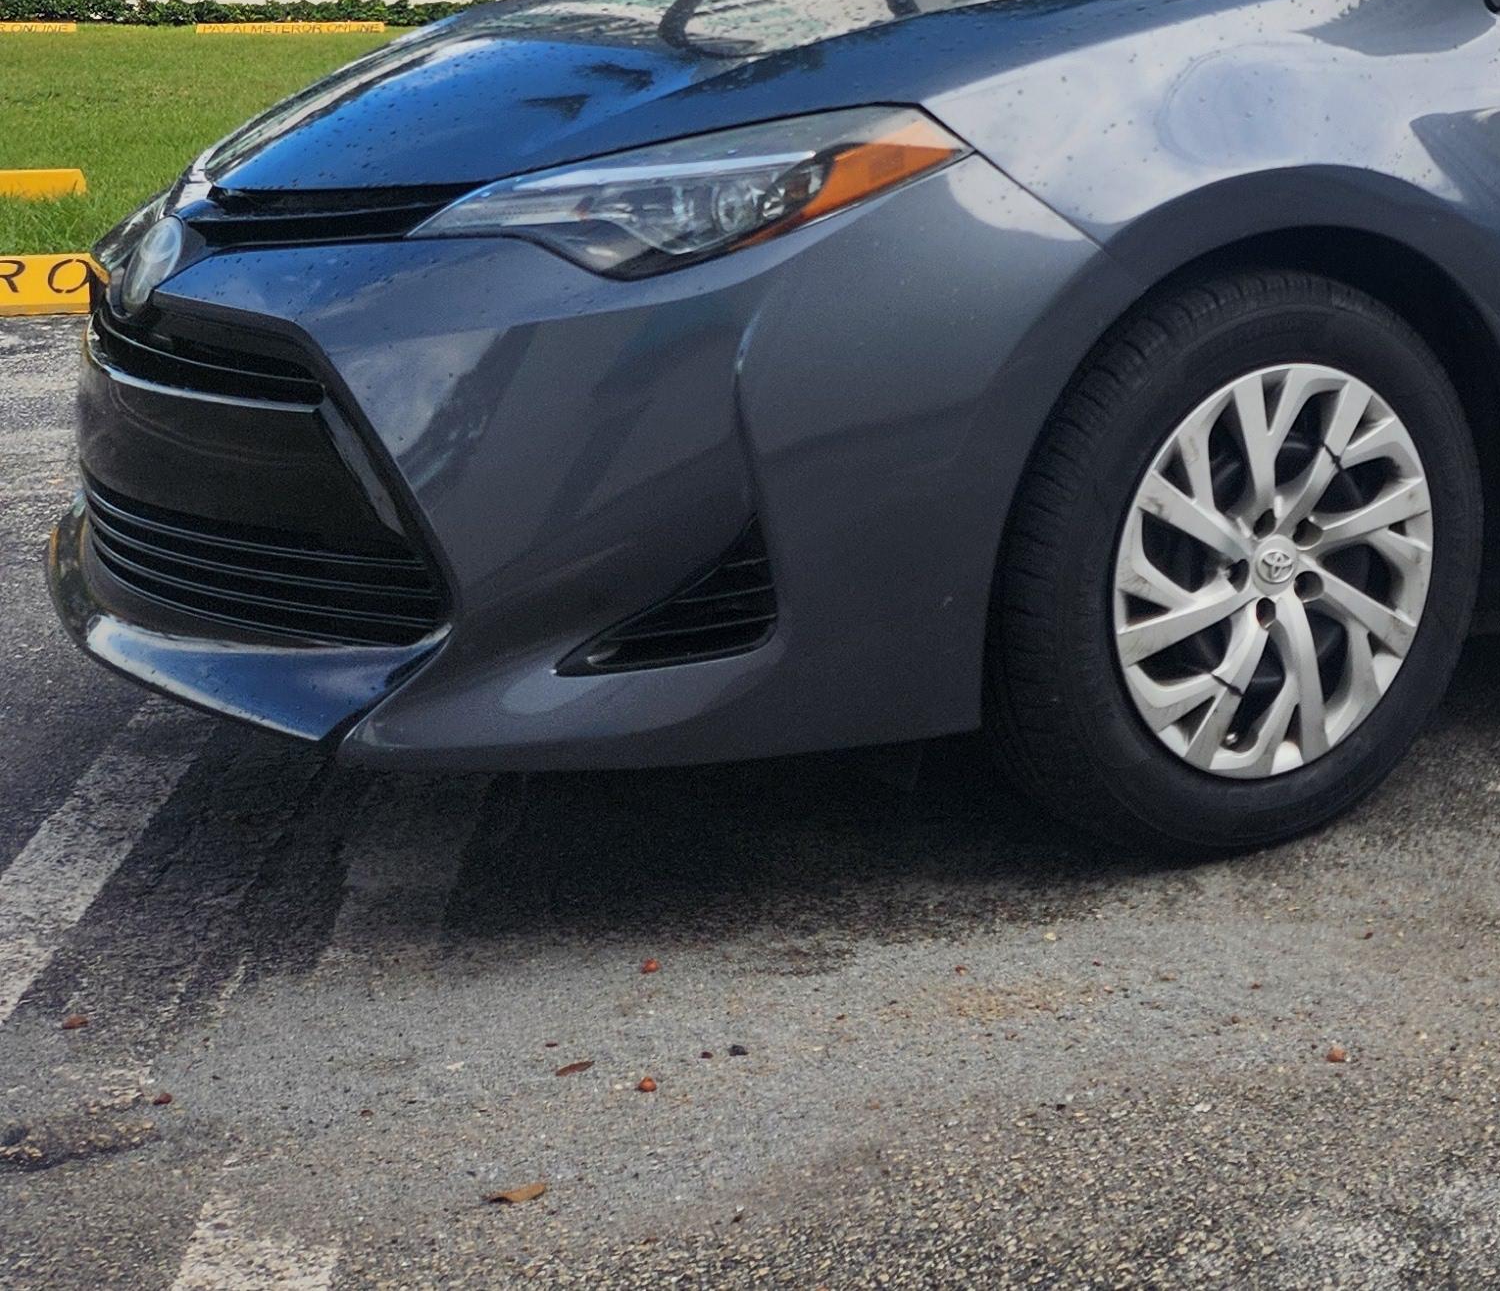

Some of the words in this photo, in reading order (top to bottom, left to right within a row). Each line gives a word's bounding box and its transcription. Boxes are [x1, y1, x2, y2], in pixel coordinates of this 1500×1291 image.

[203, 24, 229, 33] PAY
[250, 24, 299, 33] METER
[300, 24, 322, 33] OR
[327, 24, 381, 33] ONLINE
